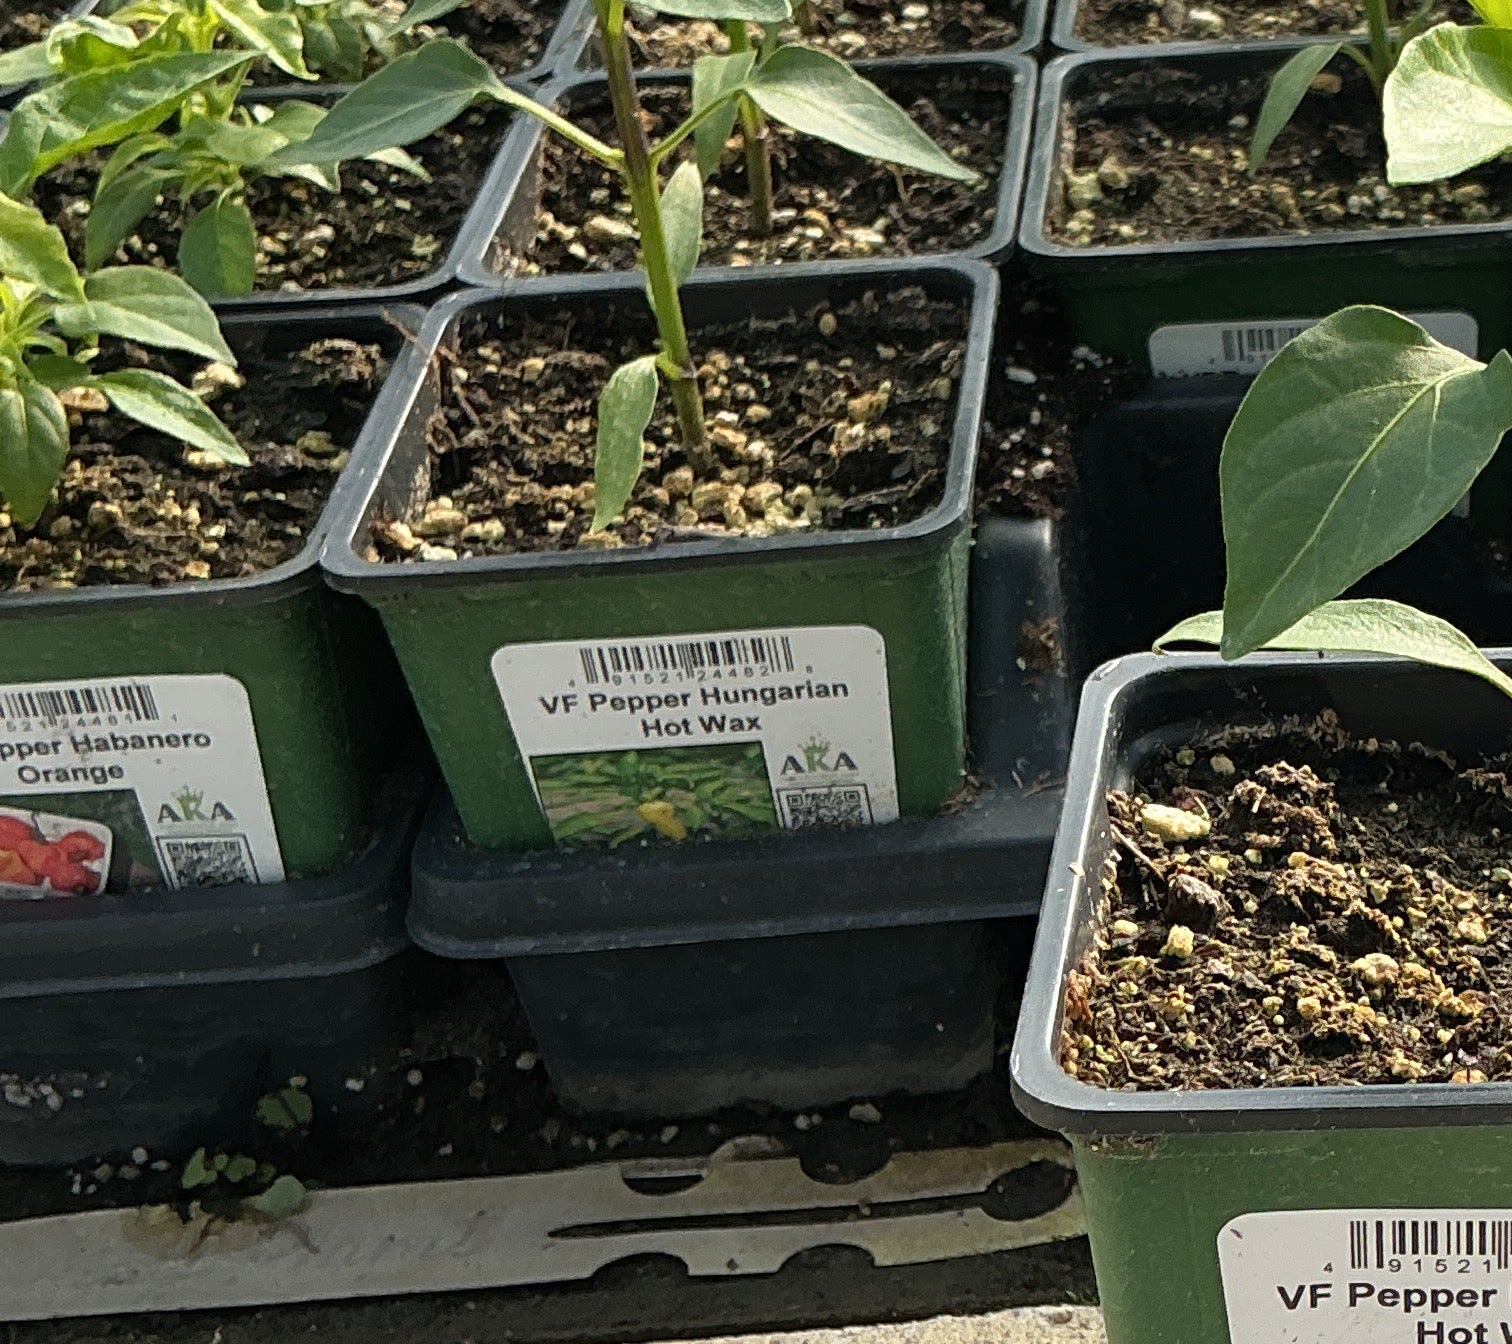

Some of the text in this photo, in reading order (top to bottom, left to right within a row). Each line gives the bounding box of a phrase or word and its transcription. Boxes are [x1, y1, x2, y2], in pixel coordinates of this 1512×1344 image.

[538, 679, 849, 715] VF Pepper Hungarian
[641, 713, 763, 738] Hot Wax
[0, 731, 211, 761] pper Habanero
[18, 764, 125, 784] Orange
[780, 751, 859, 775] AKA
[1277, 1283, 1333, 1310] VF
[1348, 1282, 1498, 1313] Pepper
